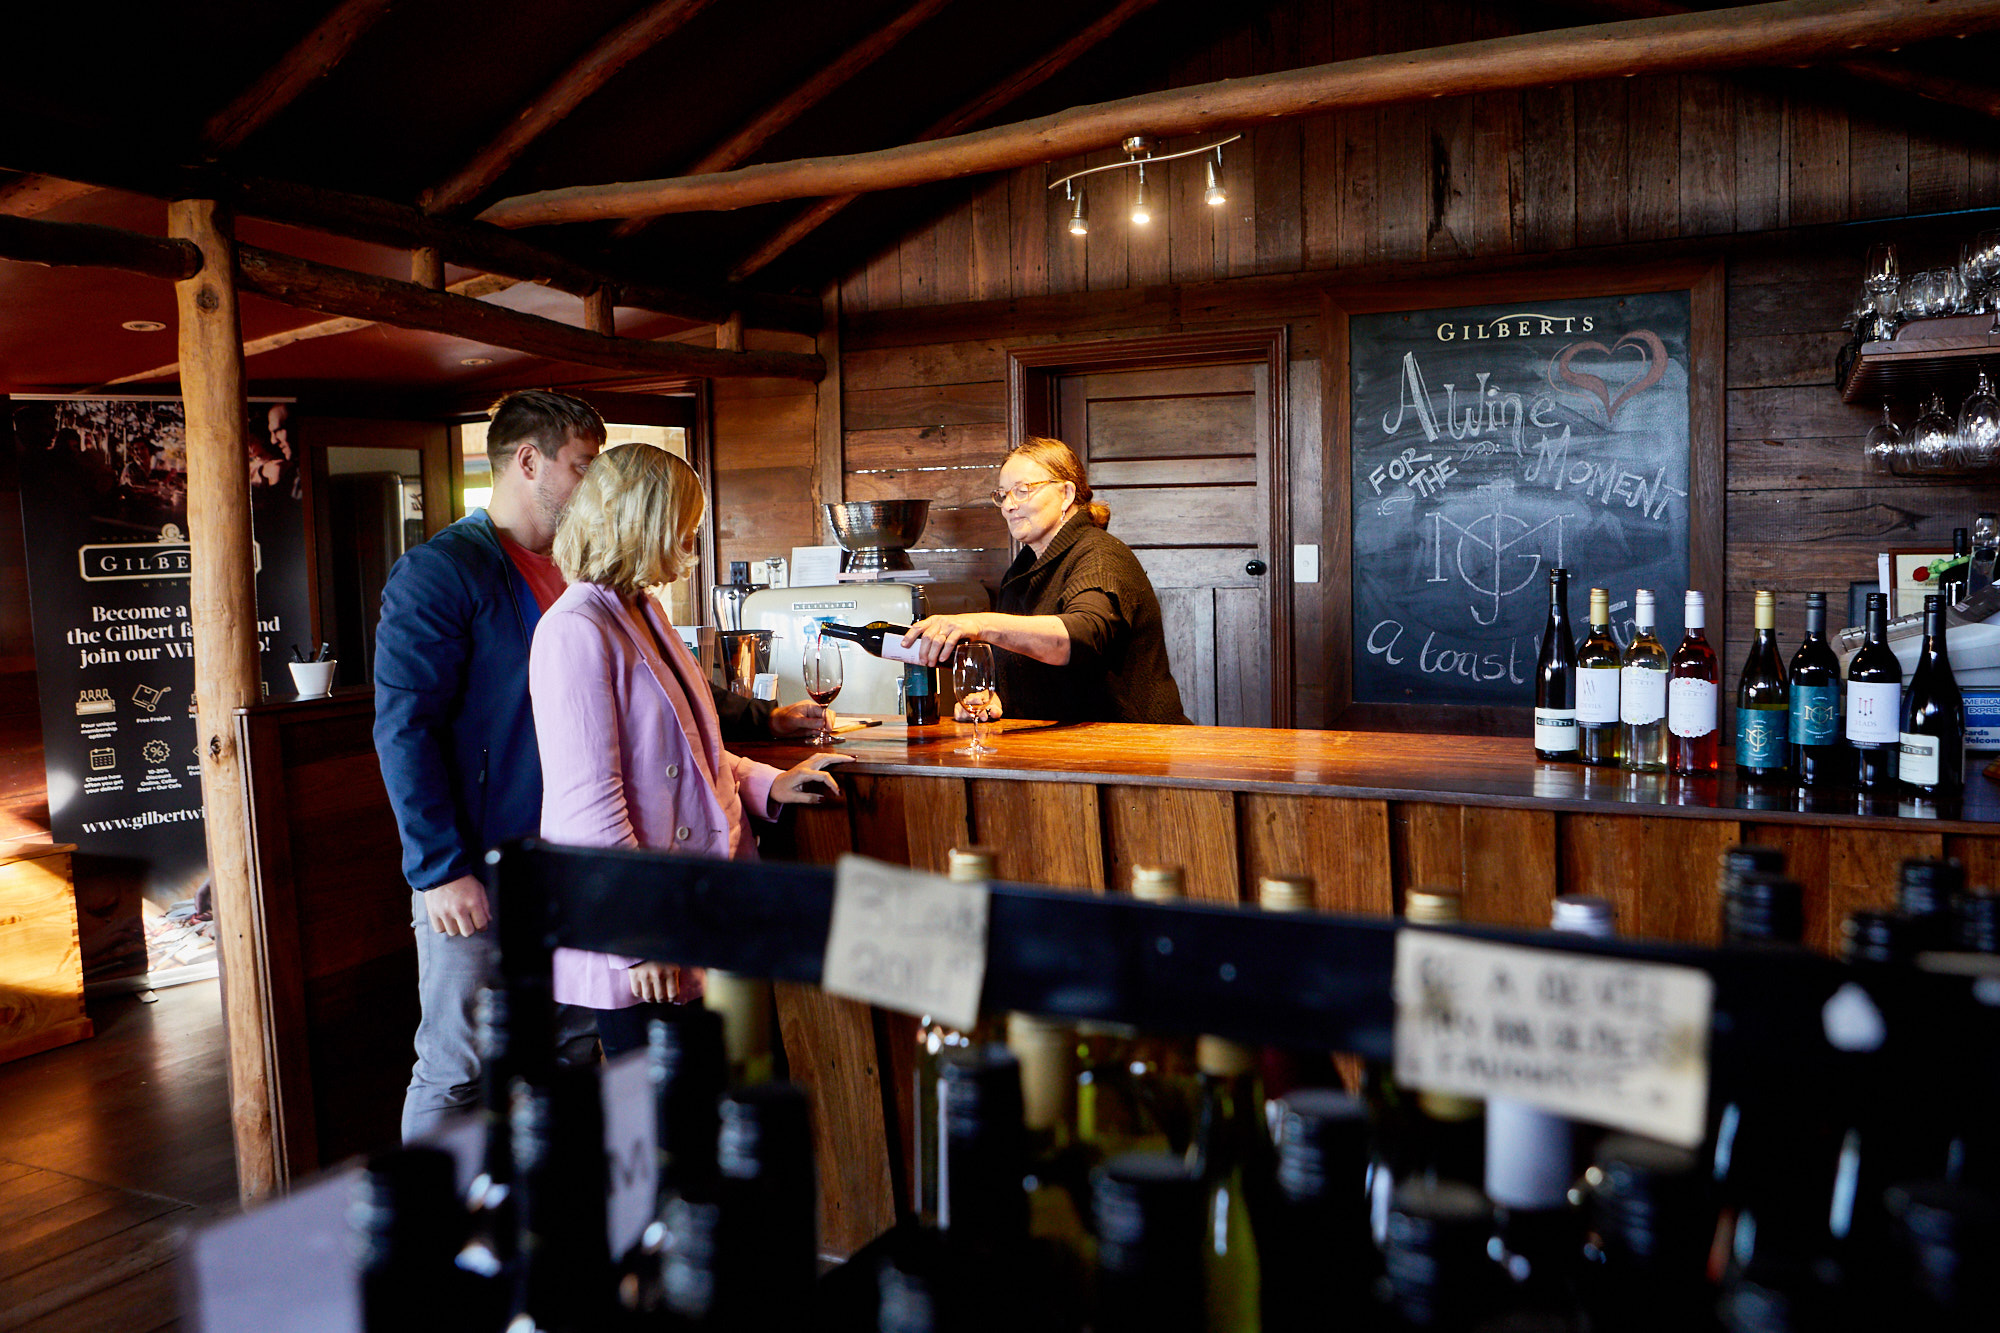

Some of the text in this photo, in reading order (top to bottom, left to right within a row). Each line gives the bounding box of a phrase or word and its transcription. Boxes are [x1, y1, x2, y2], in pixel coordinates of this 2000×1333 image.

[1436, 314, 1595, 342] GILBERTS
[1382, 351, 1560, 459] A Wine
[1368, 447, 1459, 498] FOR THE
[1523, 424, 1688, 521] MOMENT
[100, 555, 189, 572] GILBE
[92, 604, 188, 623] Become a
[66, 626, 101, 645] the
[105, 623, 175, 643] Gilbert
[257, 615, 281, 633] nd
[79, 641, 195, 670] join our Wi
[1418, 631, 1525, 685] toast
[1962, 697, 2000, 706] AMERICA
[1967, 706, 2000, 715] EXPRE
[82, 805, 206, 834] www.gilbertwi
